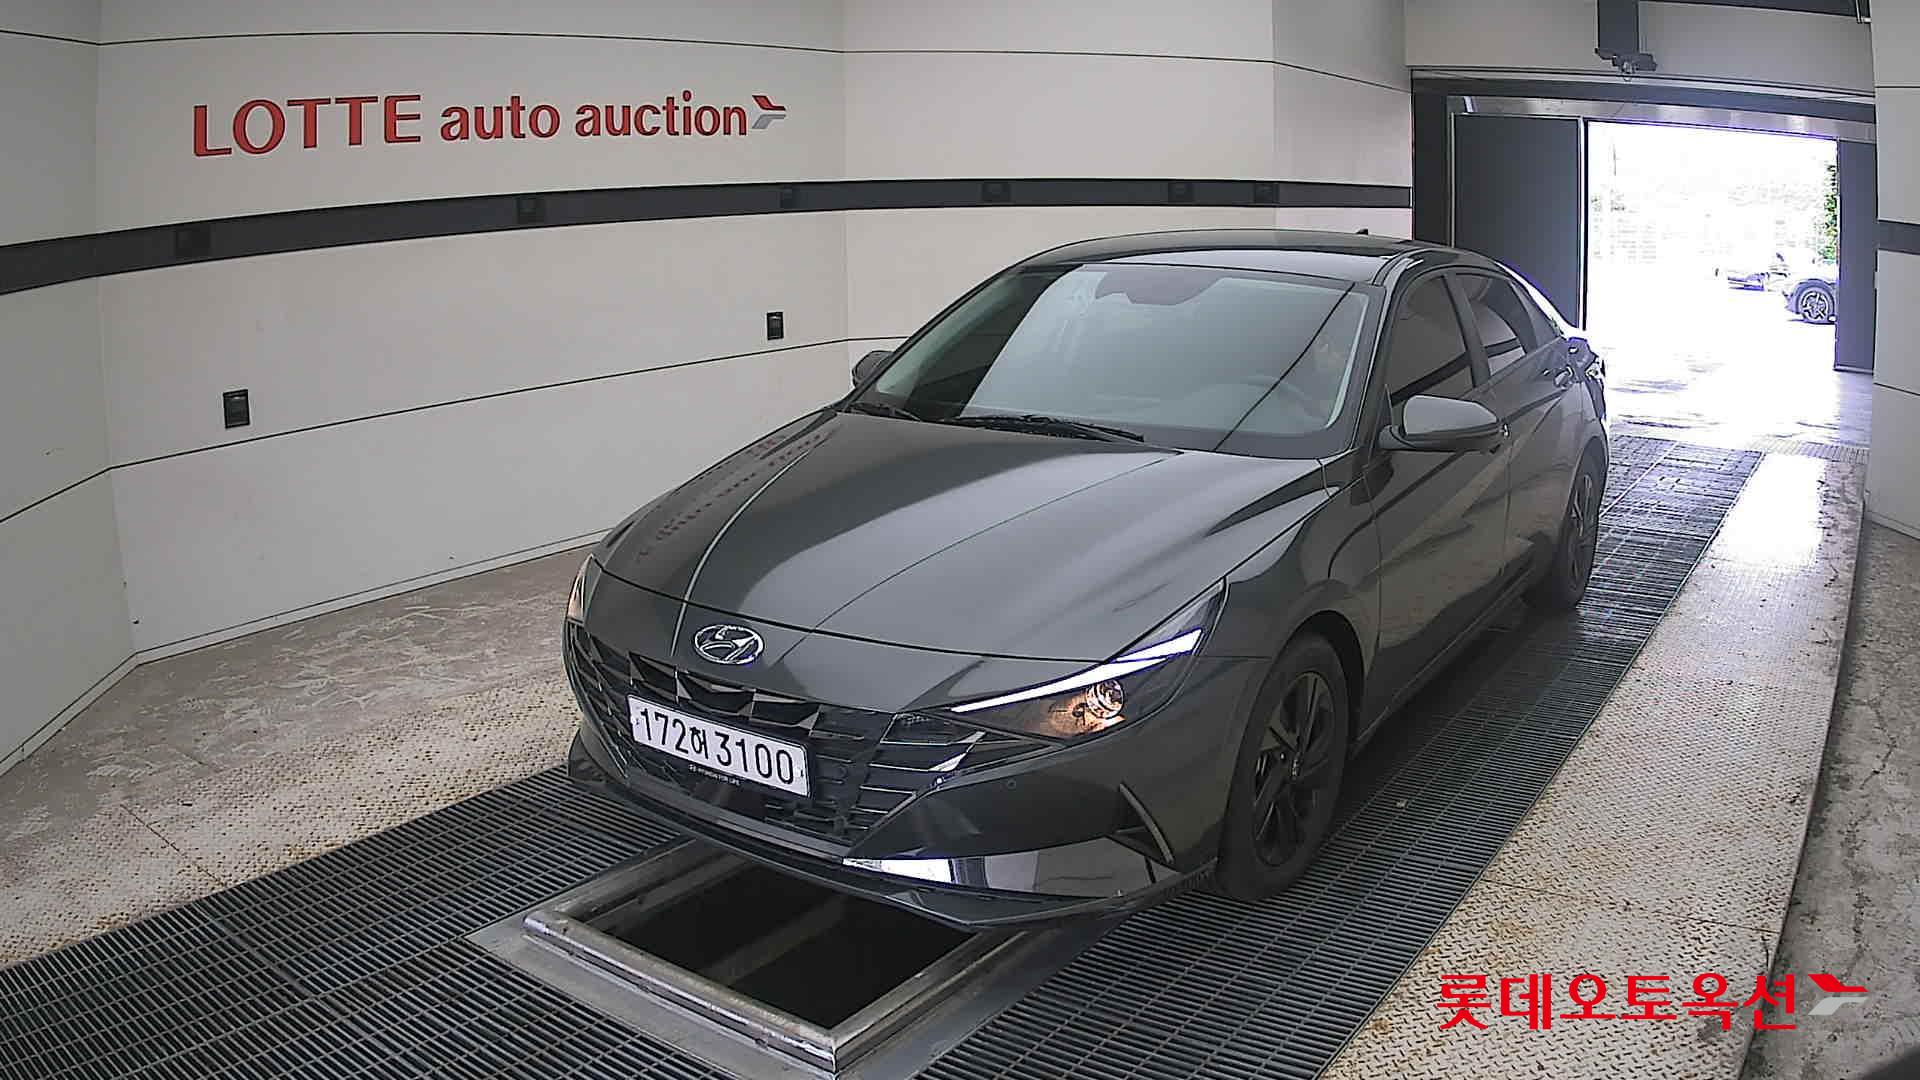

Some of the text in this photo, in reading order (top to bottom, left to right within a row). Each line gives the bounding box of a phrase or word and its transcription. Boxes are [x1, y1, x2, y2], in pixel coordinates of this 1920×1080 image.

[193, 89, 748, 157] LOTTE auto auction
